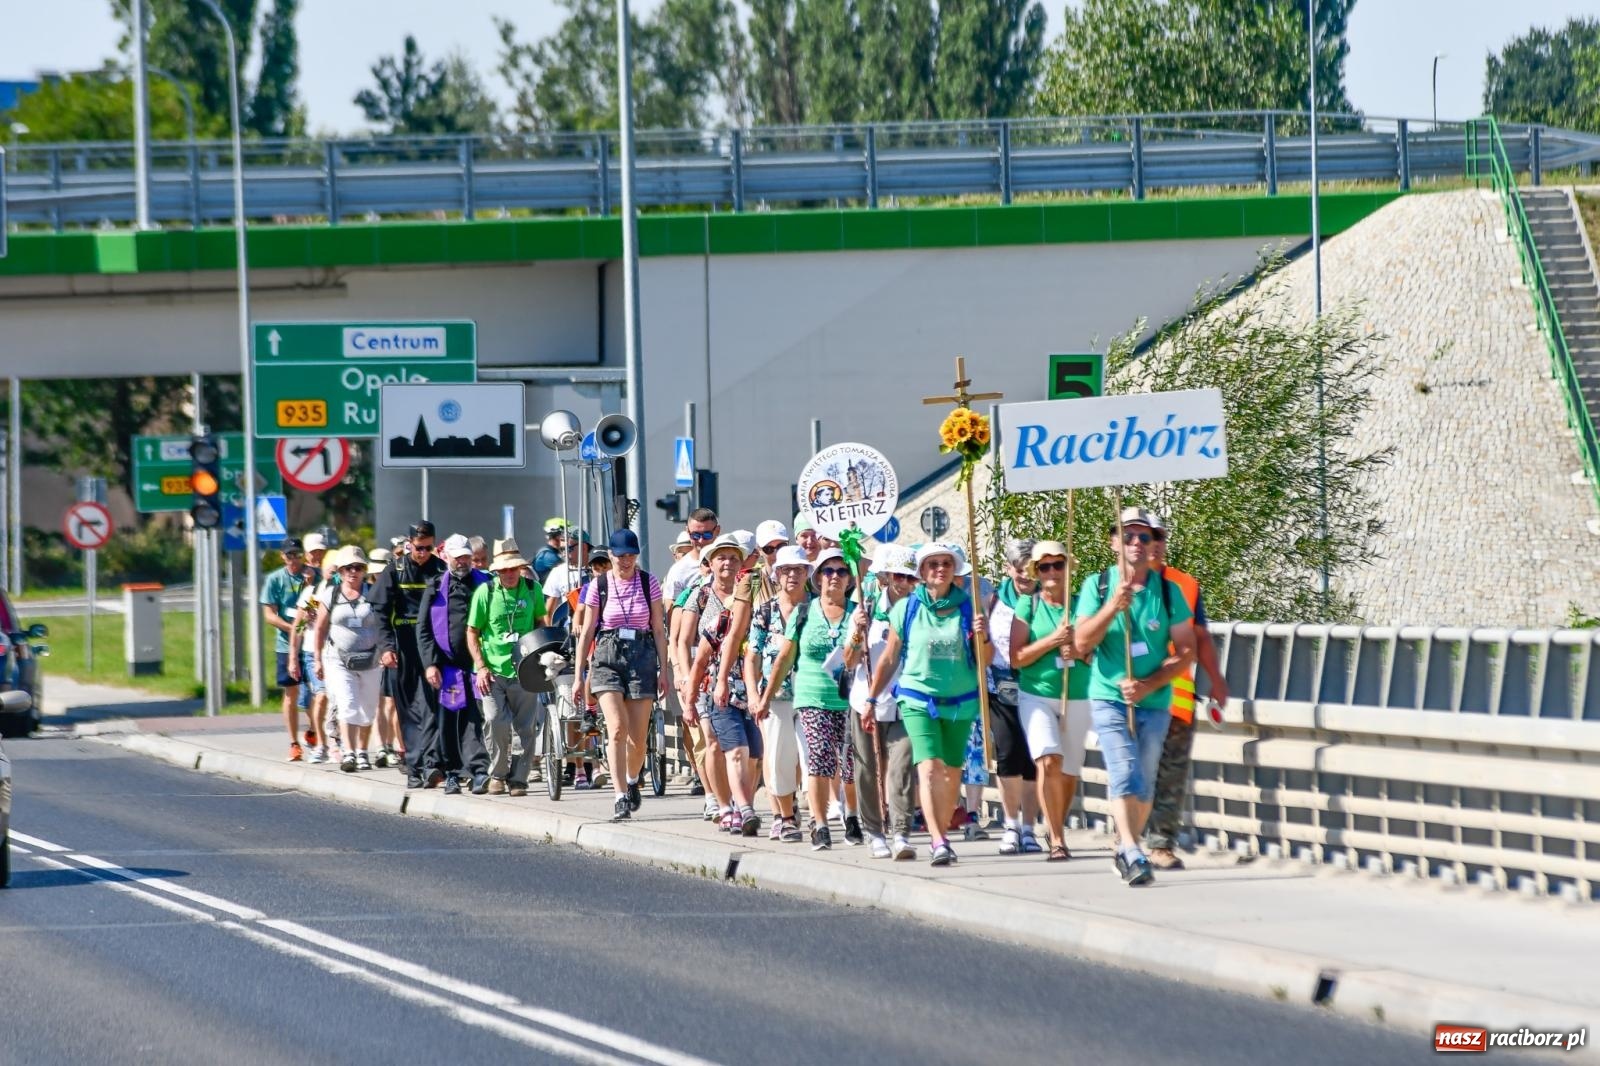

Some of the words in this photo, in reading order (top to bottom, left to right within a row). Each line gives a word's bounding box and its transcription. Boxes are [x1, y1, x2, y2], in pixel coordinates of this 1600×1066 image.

[351, 332, 439, 350] Centrum
[1056, 361, 1095, 398] 5
[284, 405, 323, 423] 935
[344, 402, 376, 424] Ru
[1012, 413, 1221, 469] Racibórz
[840, 446, 878, 461] TOMASZA
[816, 499, 887, 524] KIETRZ
